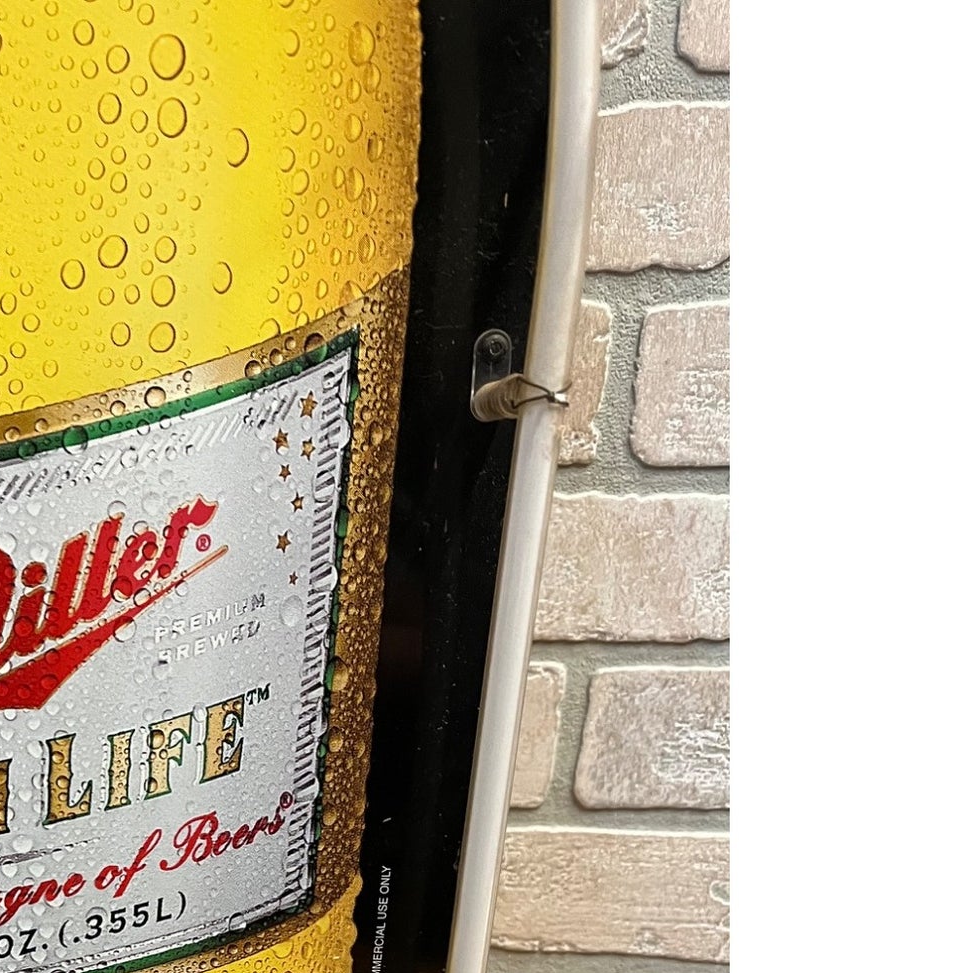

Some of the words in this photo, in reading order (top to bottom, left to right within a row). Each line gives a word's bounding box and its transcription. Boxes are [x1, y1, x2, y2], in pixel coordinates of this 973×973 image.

[40, 693, 245, 827] LIFE
[94, 828, 163, 898] of
[379, 865, 392, 895] ONLY
[58, 891, 187, 948] (.355L)
[377, 897, 389, 921] USE
